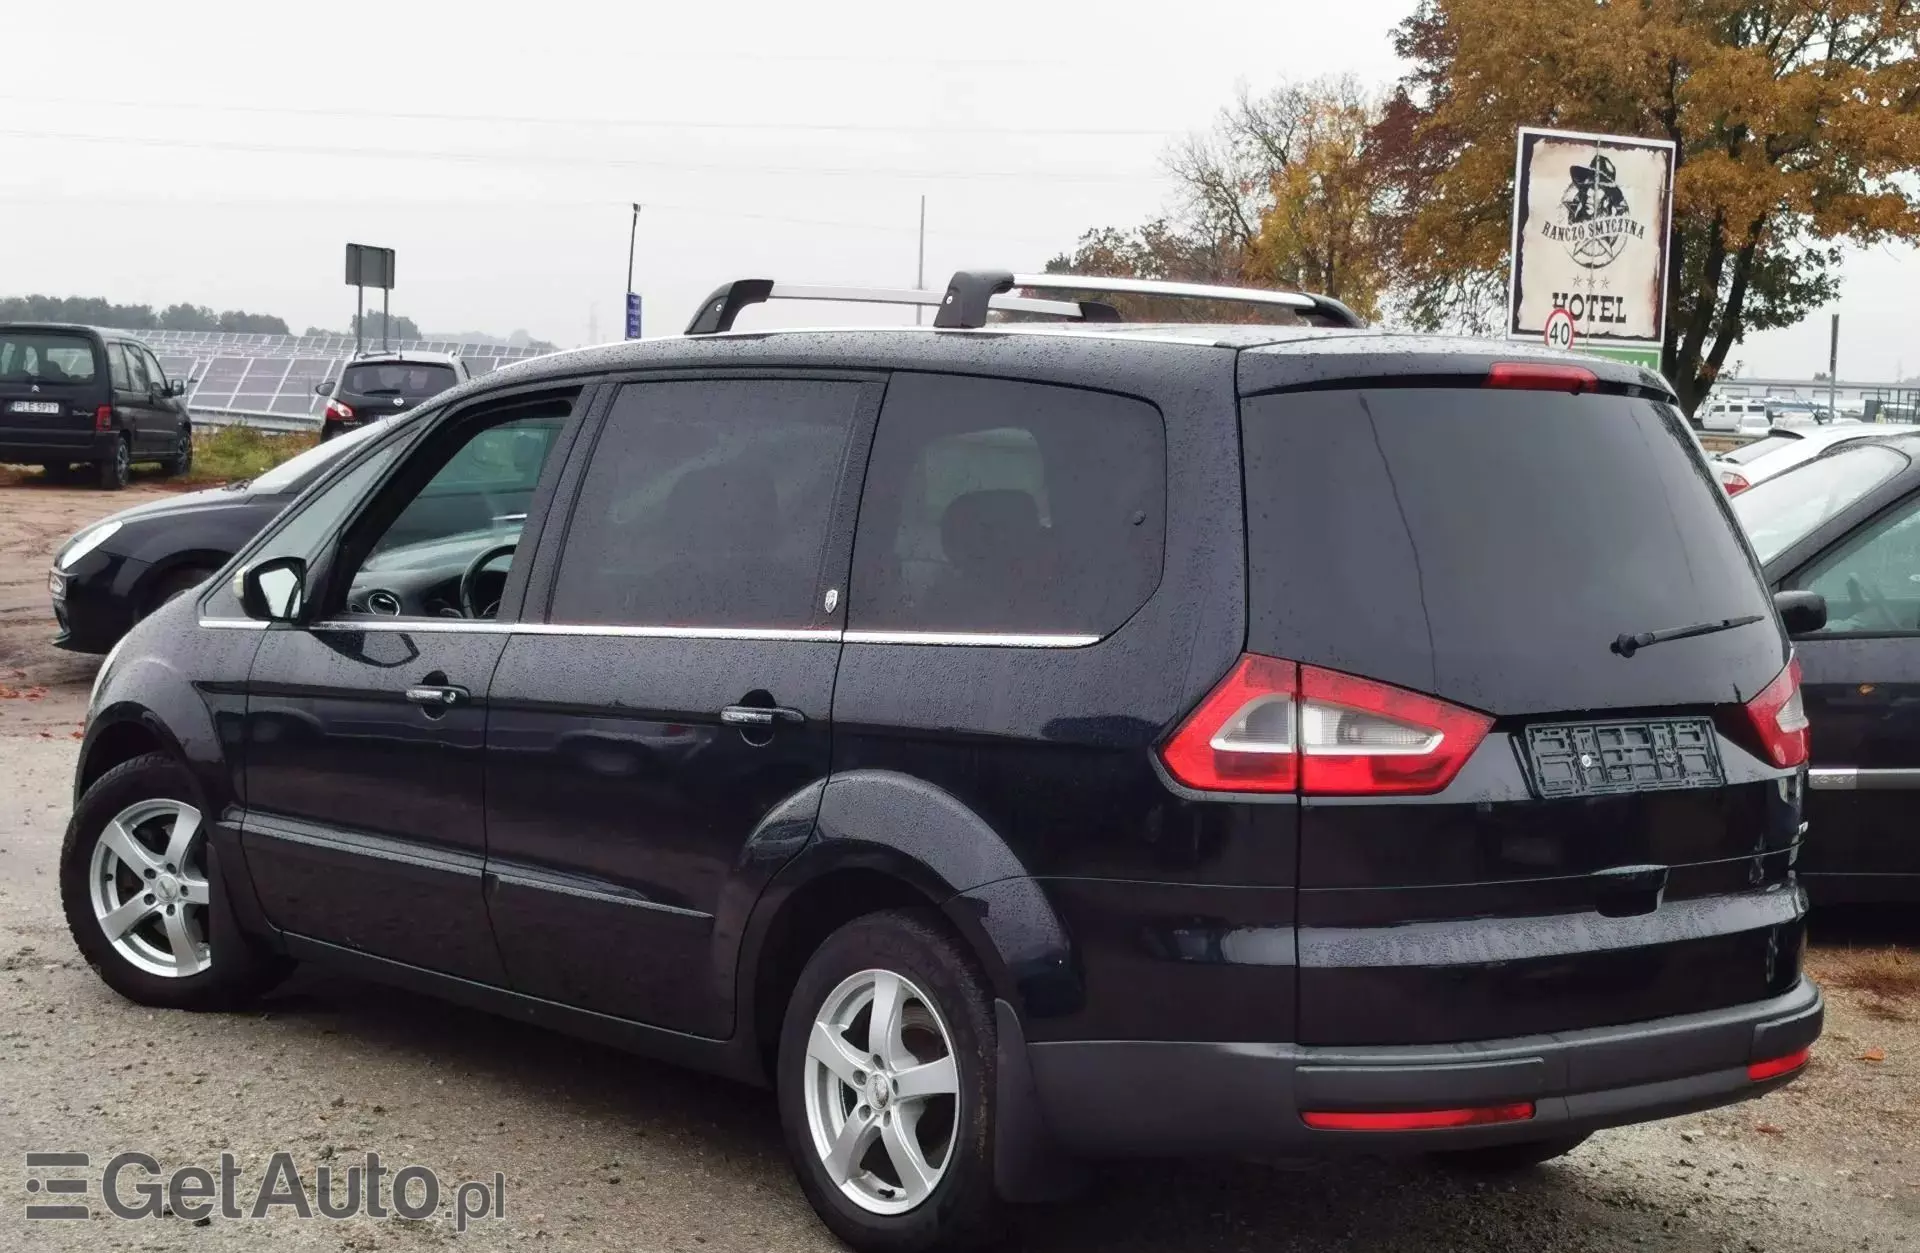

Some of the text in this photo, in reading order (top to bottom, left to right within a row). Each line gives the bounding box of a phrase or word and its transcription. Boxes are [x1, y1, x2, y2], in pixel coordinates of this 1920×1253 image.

[1541, 218, 1645, 241] RANCZO SMYCZYNA
[1552, 292, 1627, 324] HOTEL
[1549, 321, 1570, 345] 40
